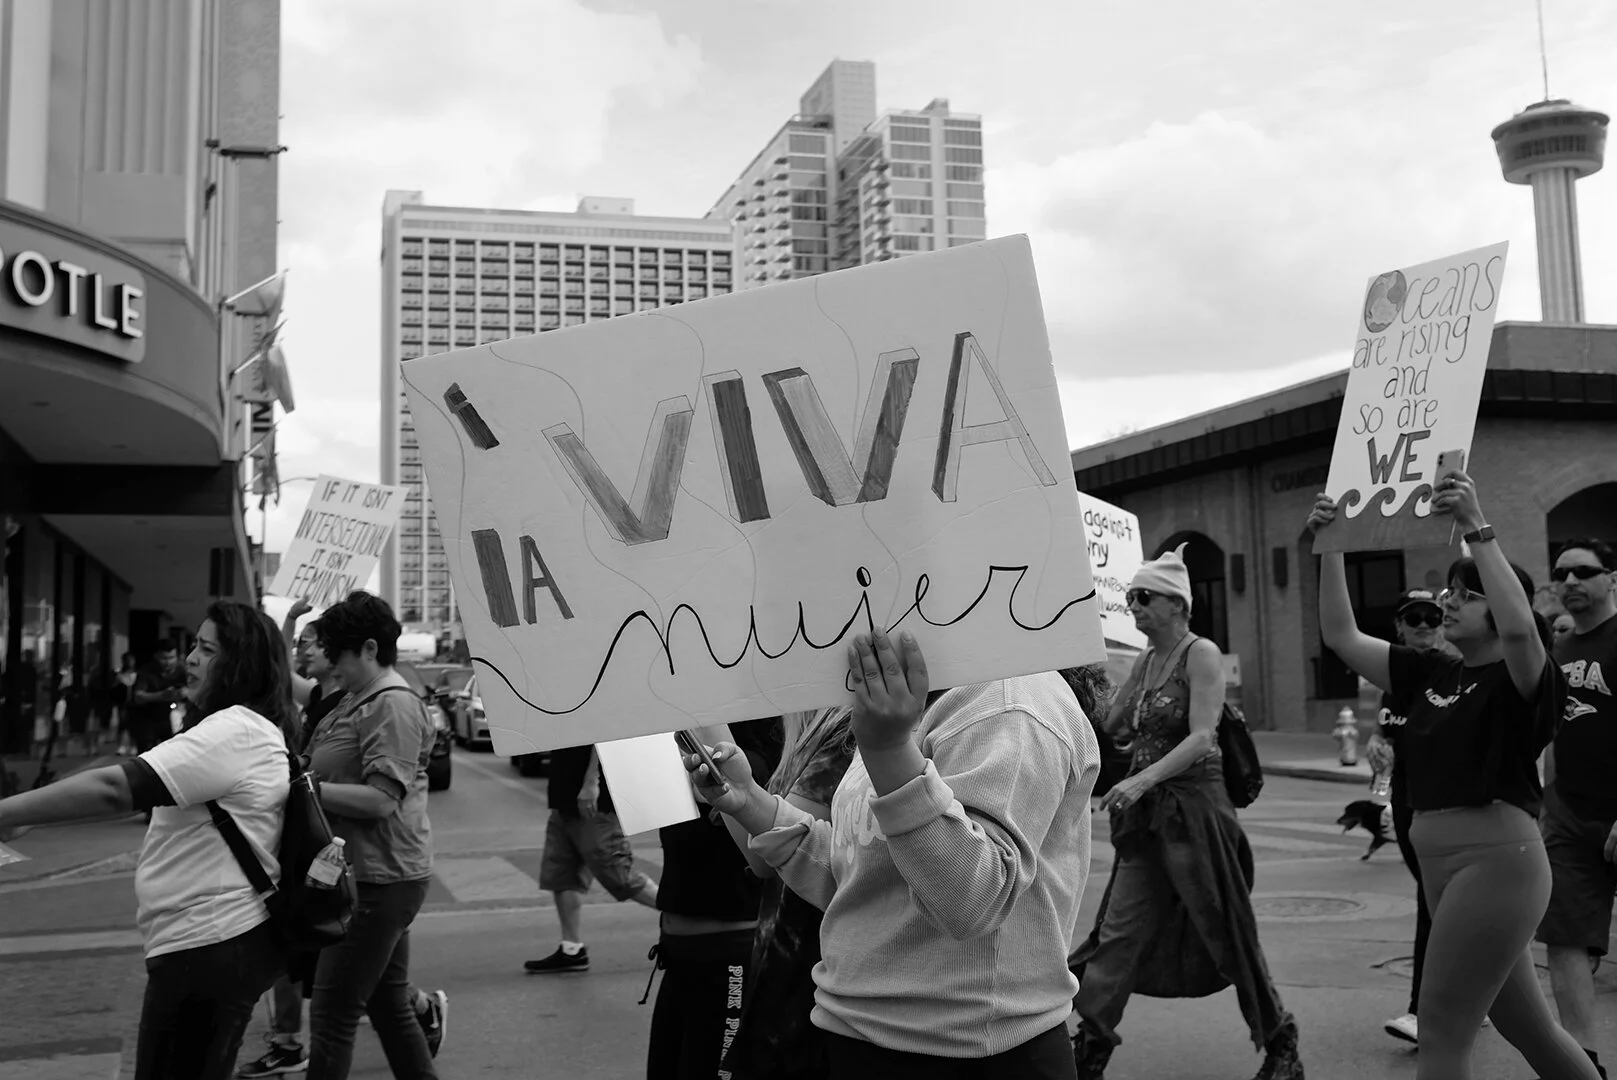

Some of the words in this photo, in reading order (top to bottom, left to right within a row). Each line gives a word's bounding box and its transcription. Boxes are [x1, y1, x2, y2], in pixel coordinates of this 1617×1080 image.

[0, 247, 143, 338] OTLE
[1353, 334, 1388, 369] are
[1397, 314, 1471, 364] rising
[1383, 357, 1433, 399] and
[1352, 403, 1383, 435] so
[1397, 398, 1438, 429] are
[1367, 430, 1431, 485] WE
[321, 480, 340, 502] IF
[341, 484, 361, 503] IT
[310, 548, 326, 565] IT
[727, 965, 743, 1009] PINK
